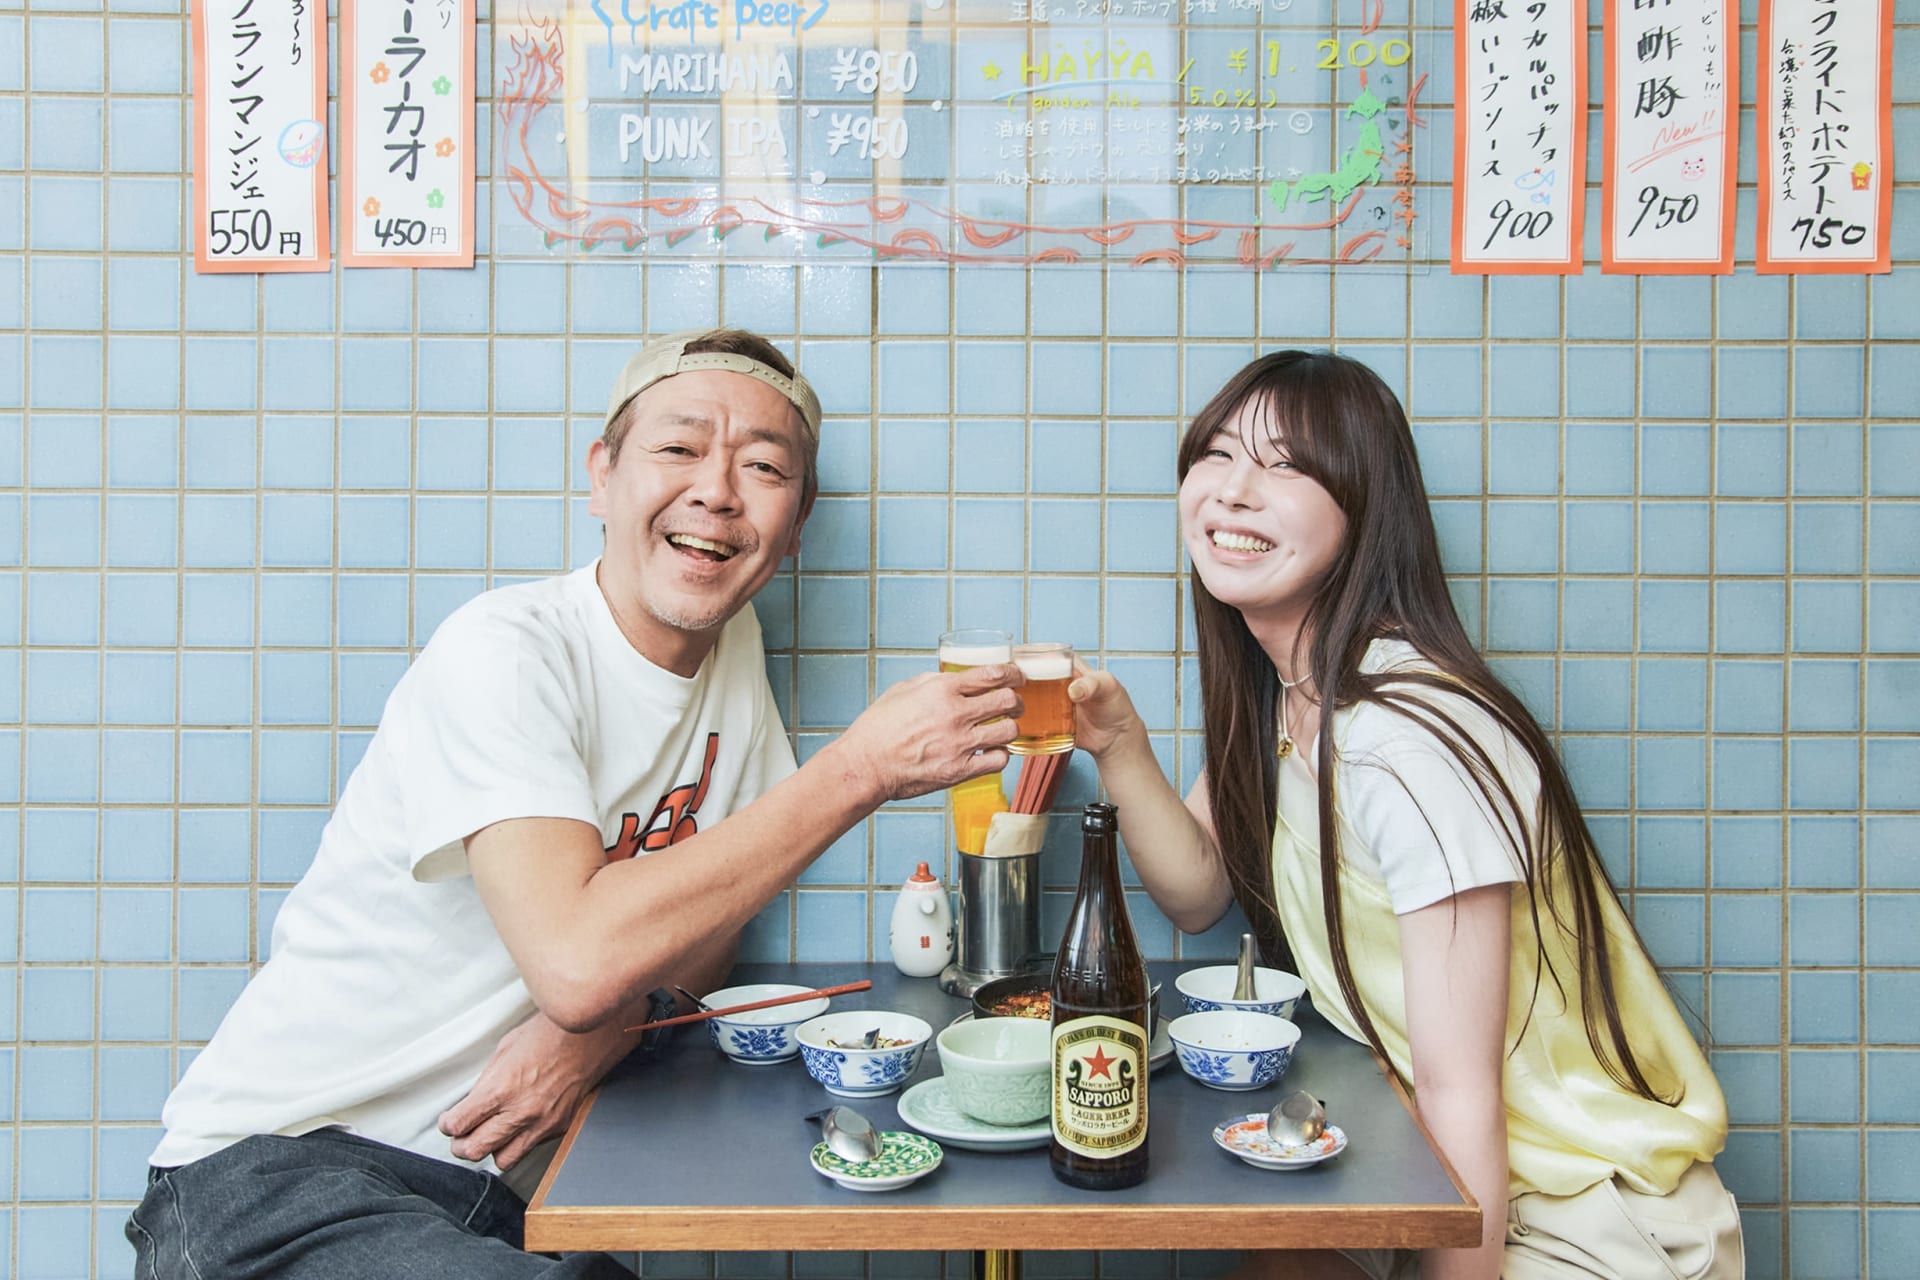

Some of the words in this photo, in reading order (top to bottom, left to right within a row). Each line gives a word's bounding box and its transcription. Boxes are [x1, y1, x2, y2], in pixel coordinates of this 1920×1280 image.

[620, 53, 793, 93] MARIHANA
[830, 48, 918, 94] ¥850
[1633, 0, 1691, 119] 酢豚
[383, 0, 426, 181] ーラーカオ
[1809, 0, 1849, 215] フライドポテト
[620, 113, 712, 162] PUNK
[727, 117, 788, 159] IPA
[827, 113, 909, 160] ¥950
[1483, 199, 1554, 250] 900
[1628, 186, 1699, 237] 950
[1790, 217, 1867, 252] 750
[1069, 1086, 1130, 1108] SAPPORO
[1071, 1107, 1103, 1121] LAGER
[1105, 1107, 1131, 1121] BEER
